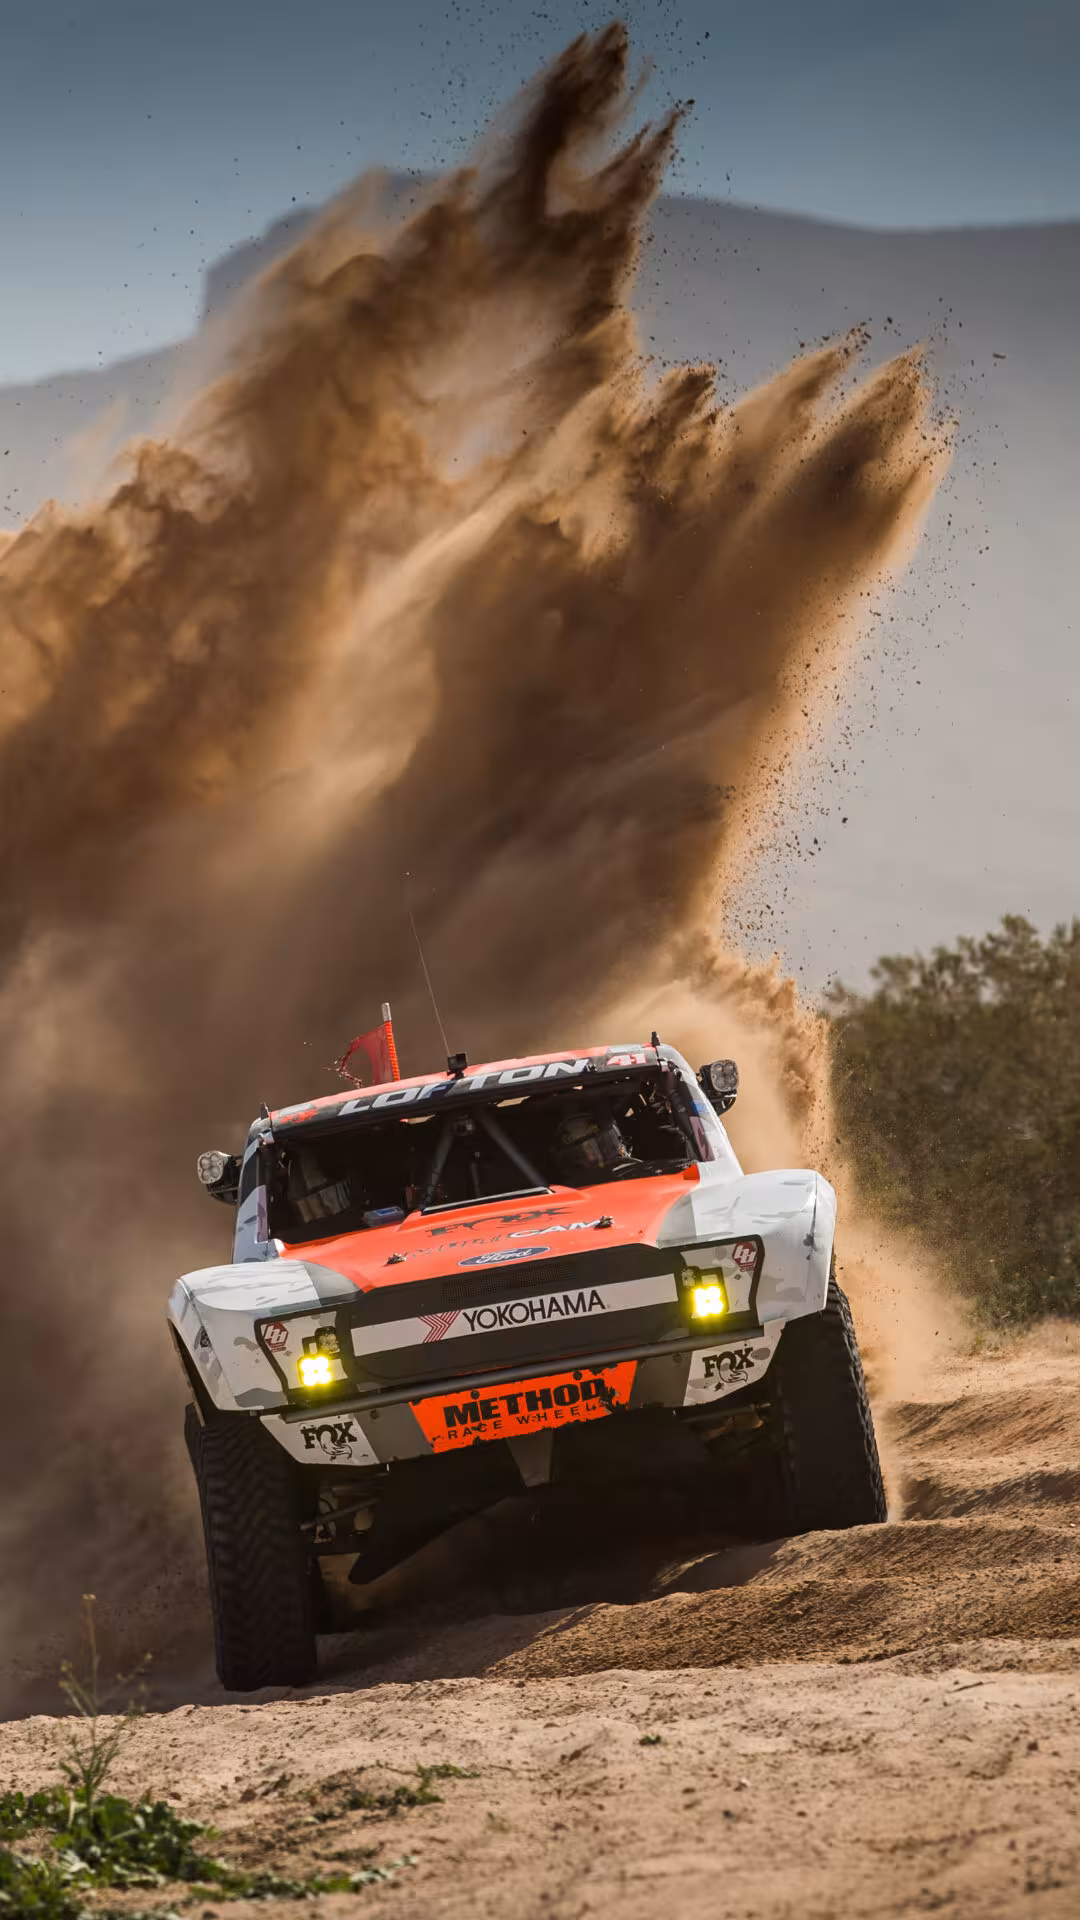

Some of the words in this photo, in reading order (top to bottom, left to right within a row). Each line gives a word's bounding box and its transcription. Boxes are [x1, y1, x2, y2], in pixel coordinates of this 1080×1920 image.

[606, 1053, 647, 1067] 41
[338, 1058, 590, 1117] LOFTON
[476, 1248, 532, 1264] Ford
[462, 1289, 607, 1332] YOKOHAMA
[702, 1347, 755, 1383] FOX
[443, 1378, 608, 1428] METHOD
[300, 1421, 358, 1457] FOX
[447, 1420, 503, 1441] RACE
